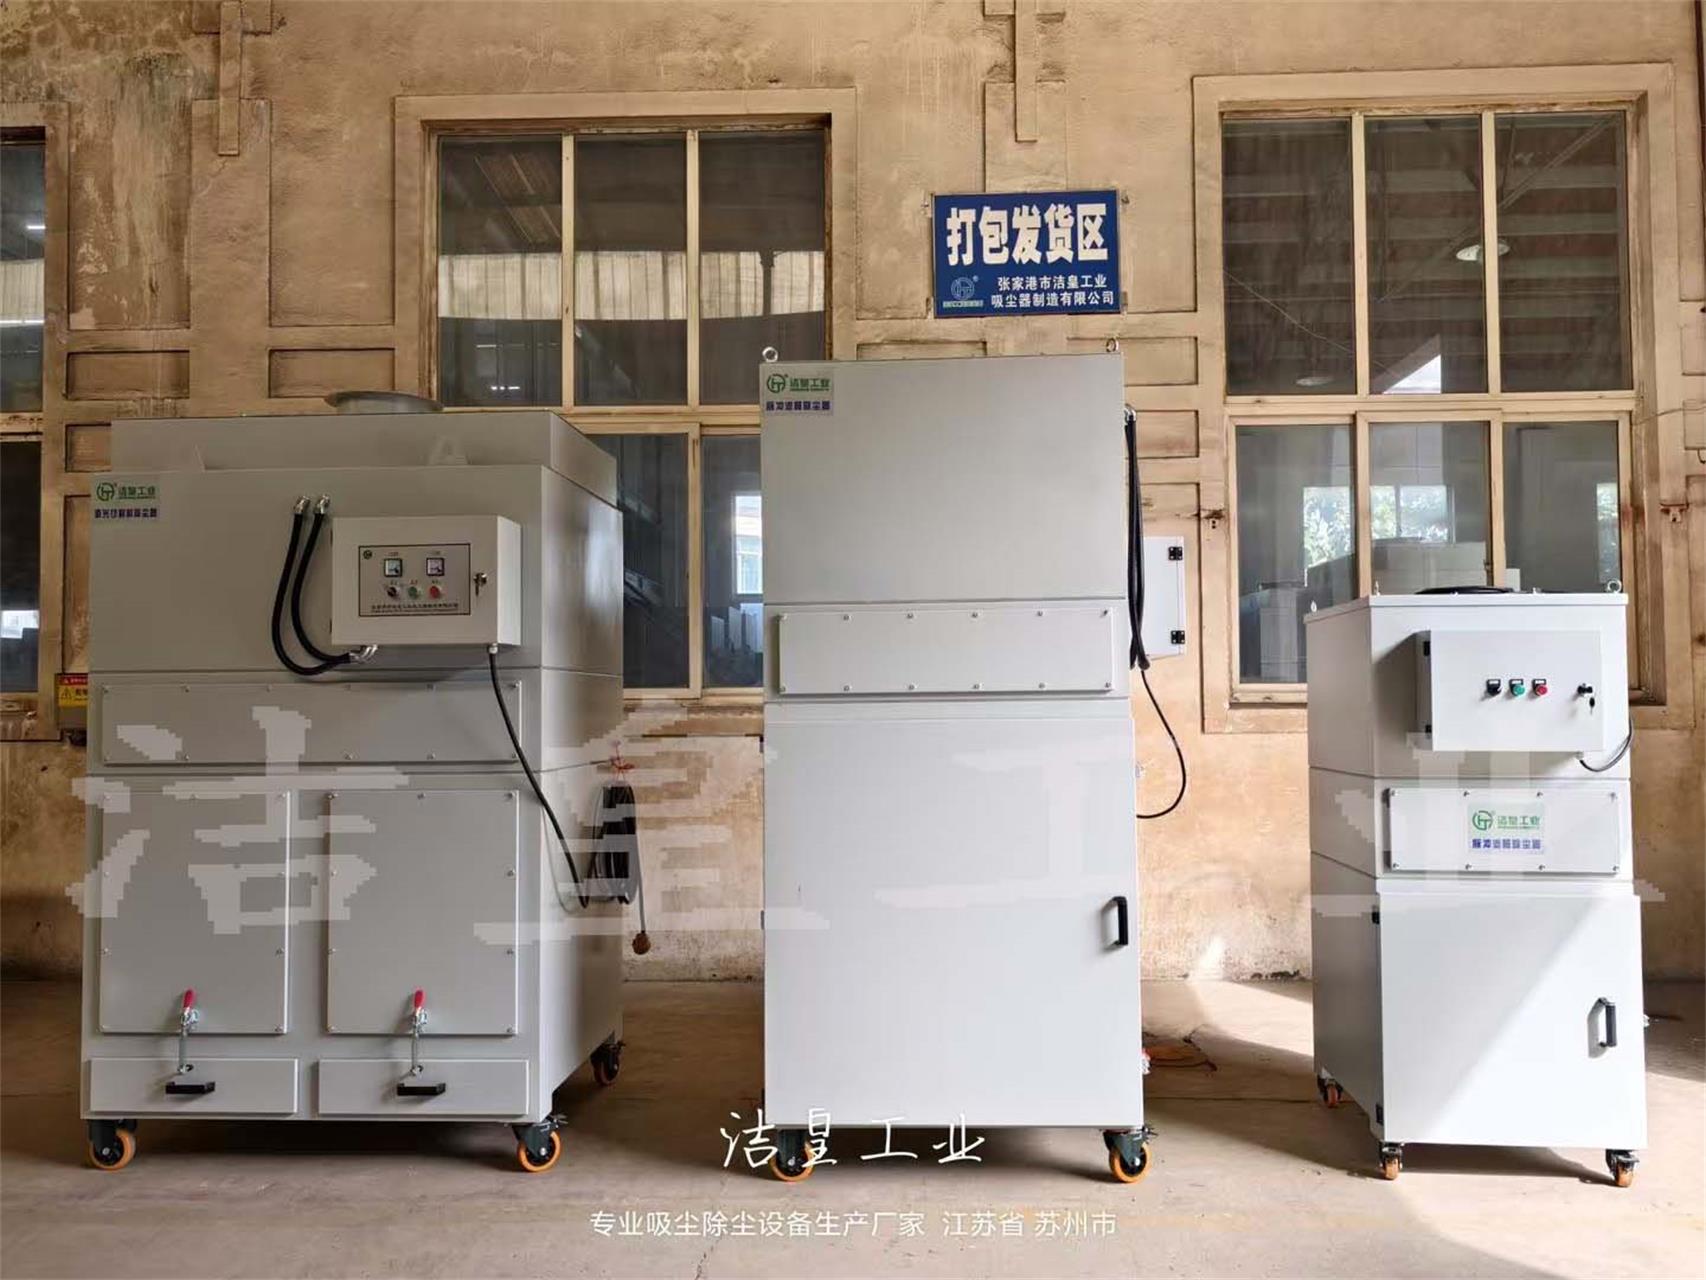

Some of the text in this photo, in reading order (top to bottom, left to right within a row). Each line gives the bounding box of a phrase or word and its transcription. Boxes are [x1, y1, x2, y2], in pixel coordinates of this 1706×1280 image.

[946, 203, 1109, 266] 打包发货区
[997, 273, 1108, 292] 张家港市洁皇工业
[990, 290, 1115, 309] 吸尘器制造有限公司
